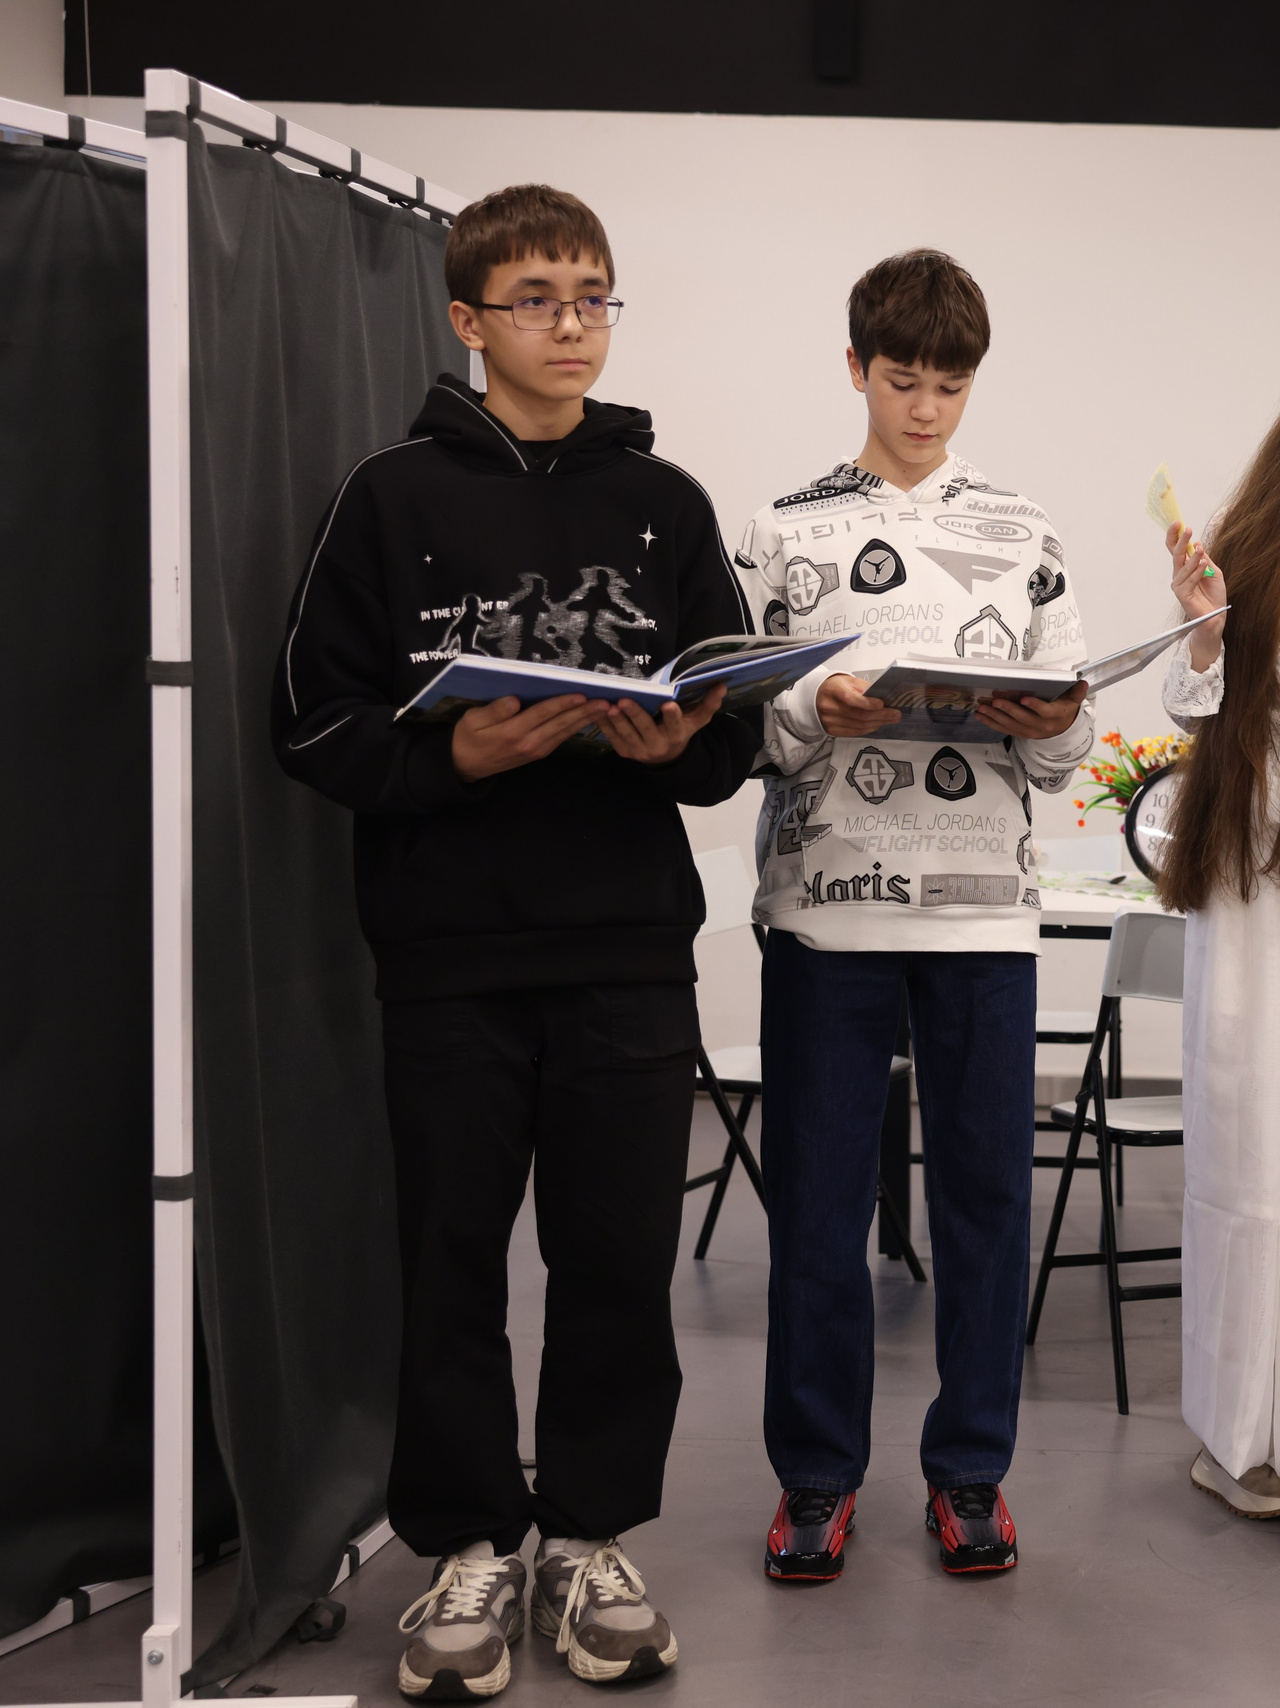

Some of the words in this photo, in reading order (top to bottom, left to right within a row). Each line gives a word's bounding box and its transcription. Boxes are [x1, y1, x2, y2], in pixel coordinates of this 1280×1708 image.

[915, 534, 1022, 557] FLIGHT
[421, 611, 430, 621] IN
[432, 608, 451, 619] THE
[867, 625, 944, 647] SCHOOL
[409, 651, 428, 664] THE
[1152, 793, 1169, 808] 10
[843, 813, 922, 833] MICHAEL
[1145, 814, 1156, 828] 9
[864, 834, 936, 853] FLIGHT
[937, 835, 1008, 854] SCHOOL
